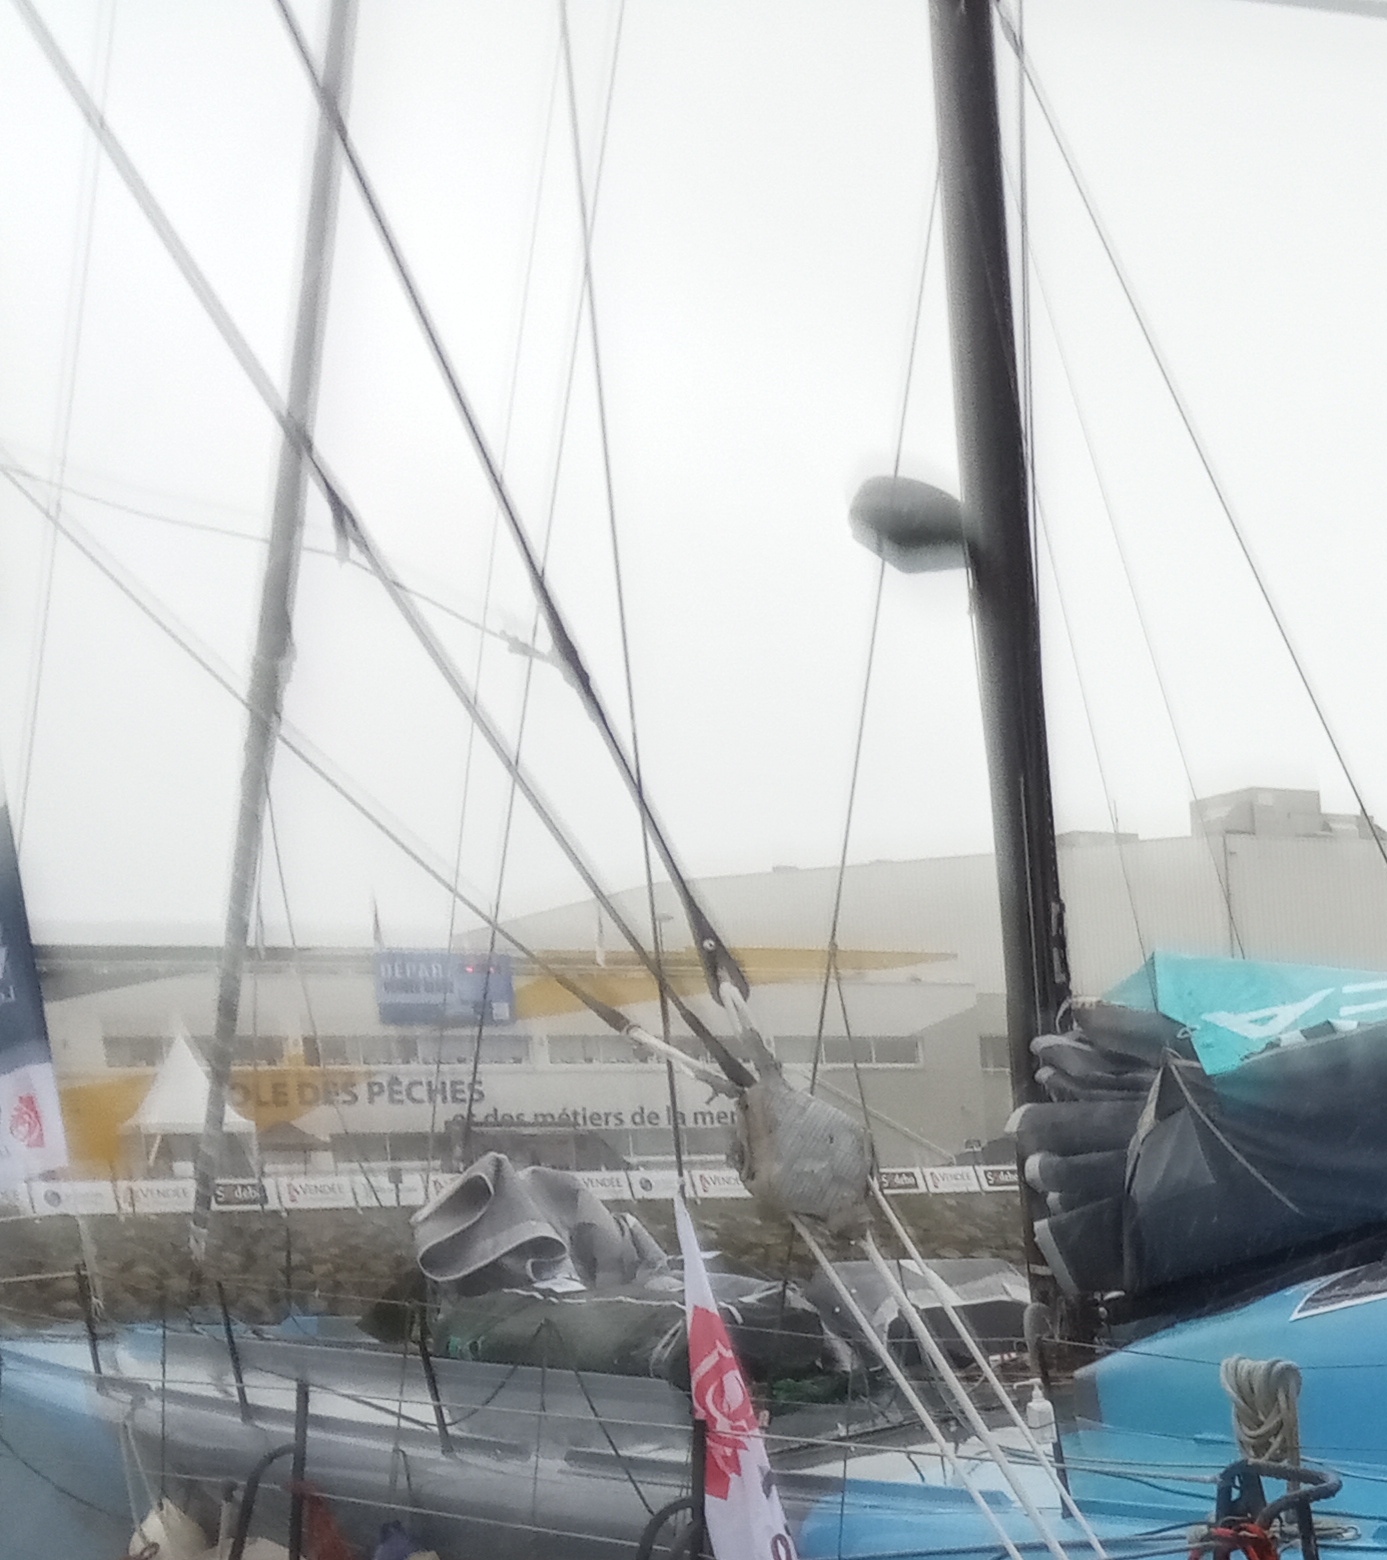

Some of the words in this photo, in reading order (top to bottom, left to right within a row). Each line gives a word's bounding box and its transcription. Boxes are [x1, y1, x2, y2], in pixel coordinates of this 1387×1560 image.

[299, 1081, 358, 1105] DES
[367, 1074, 485, 1106] PÊCHES
[533, 1107, 624, 1126] métiers
[631, 1106, 660, 1126] de
[667, 1105, 686, 1126] la
